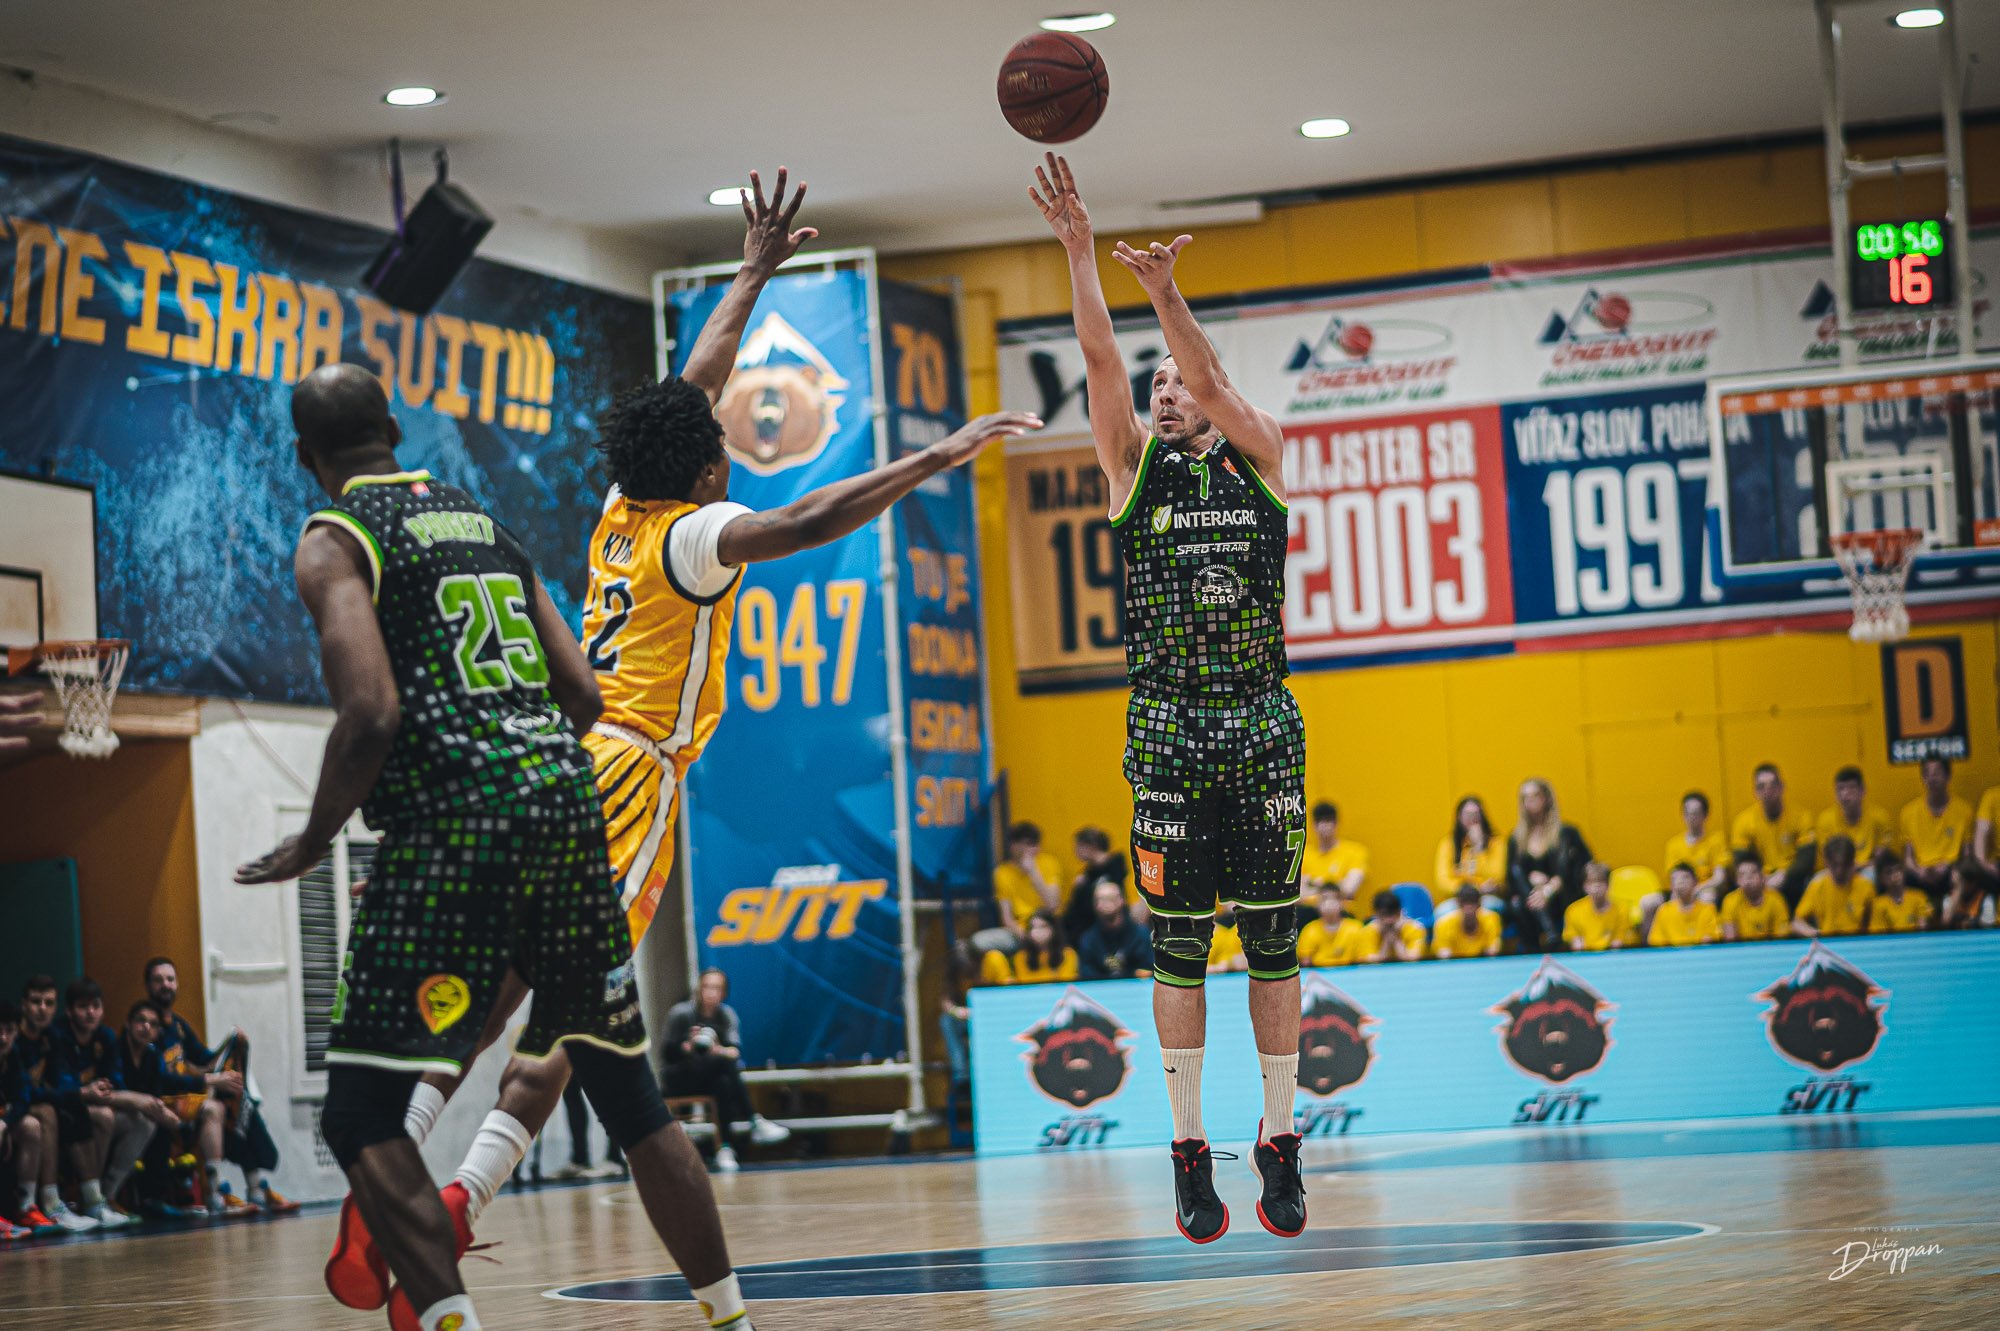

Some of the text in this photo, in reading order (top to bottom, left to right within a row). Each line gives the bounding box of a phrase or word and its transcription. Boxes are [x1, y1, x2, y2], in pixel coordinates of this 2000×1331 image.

[0, 214, 109, 346] NE
[123, 240, 344, 386] ISKRA
[1889, 253, 1933, 305] 16
[1426, 418, 1477, 480] SR
[1581, 406, 1649, 460] SLOV.
[604, 531, 633, 564] KIN
[1284, 479, 1488, 638] 2003
[1050, 516, 1128, 655] 19
[1201, 593, 1235, 605] ŠEBO
[435, 572, 549, 695] 25
[737, 579, 868, 713] 947
[1895, 647, 1954, 738] D
[1144, 822, 1186, 838] KaMi
[1265, 791, 1306, 818] SÝPK
[1285, 828, 1306, 884] 7
[706, 878, 888, 947] SVIT
